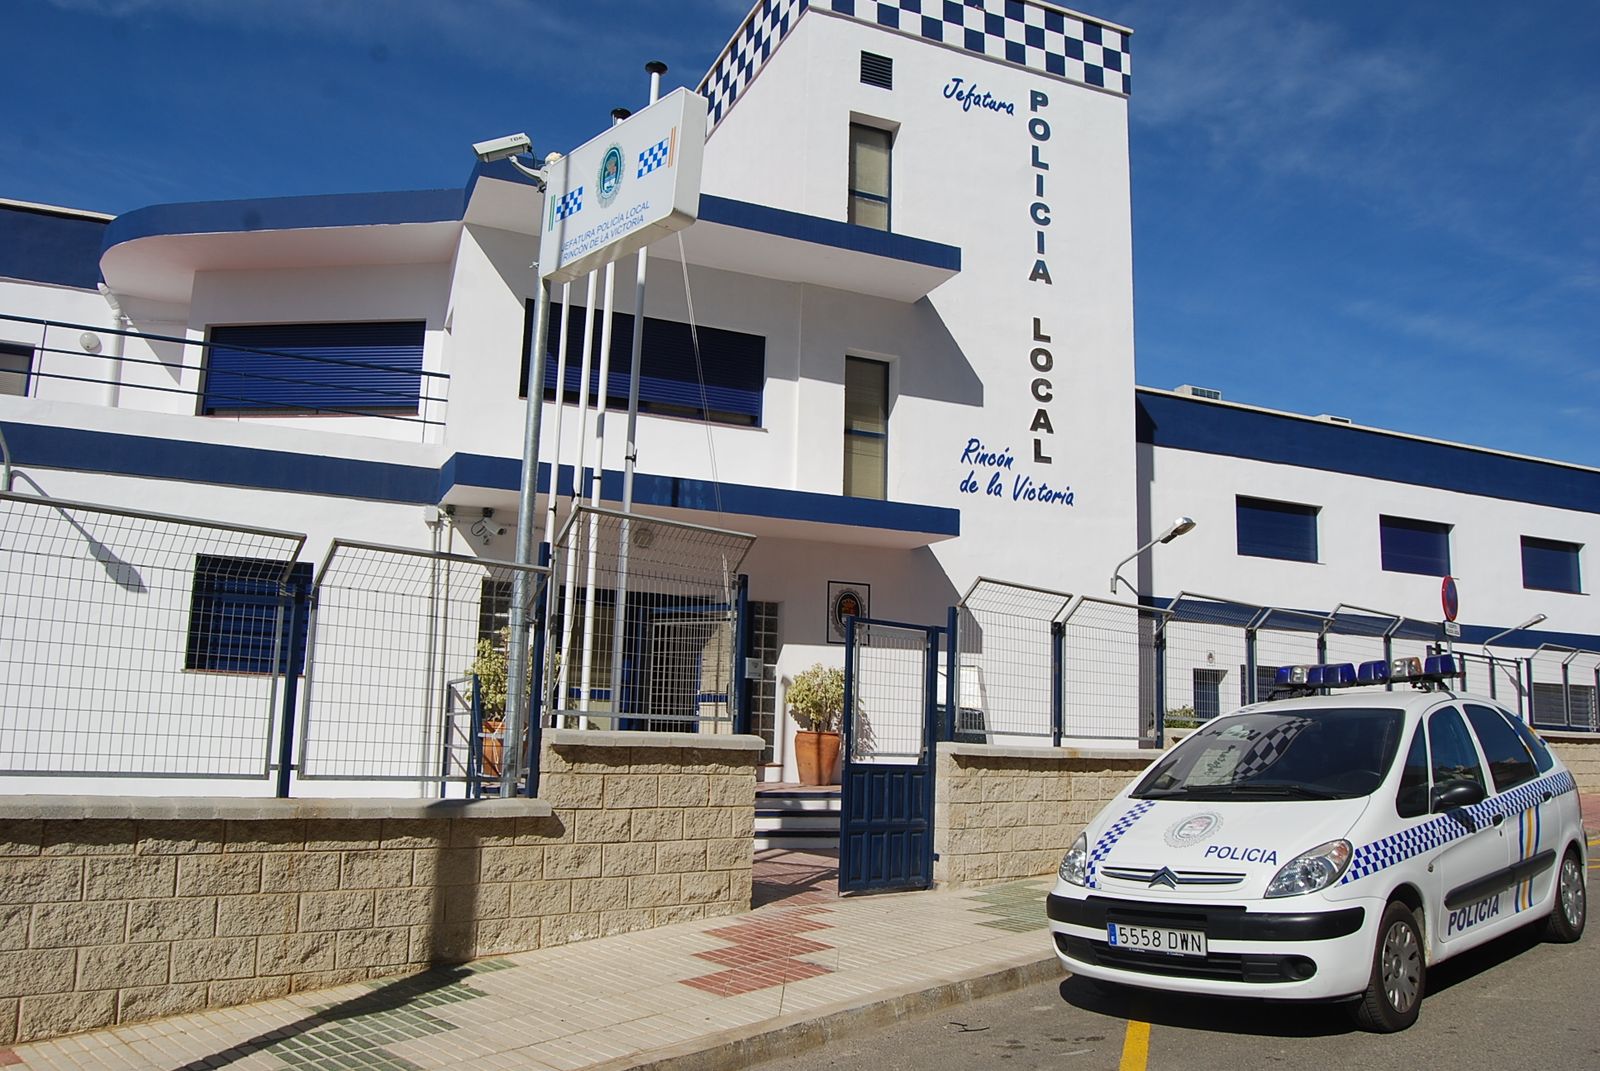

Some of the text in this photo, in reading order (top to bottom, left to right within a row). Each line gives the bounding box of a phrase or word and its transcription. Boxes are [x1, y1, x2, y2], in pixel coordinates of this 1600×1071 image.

[943, 77, 1014, 116] Jefatura
[625, 201, 650, 219] LOCAL
[589, 237, 599, 248] DE
[600, 232, 609, 243] LA
[610, 215, 644, 237] VICTORIA
[1028, 89, 1055, 465] POLICIA LOCAL
[960, 438, 1014, 470] Rincón
[959, 470, 1075, 507] de la Victoria
[1204, 845, 1277, 866] POLICIA
[1448, 894, 1499, 936] POLICIA
[1119, 926, 1202, 953] 5558 DWN
